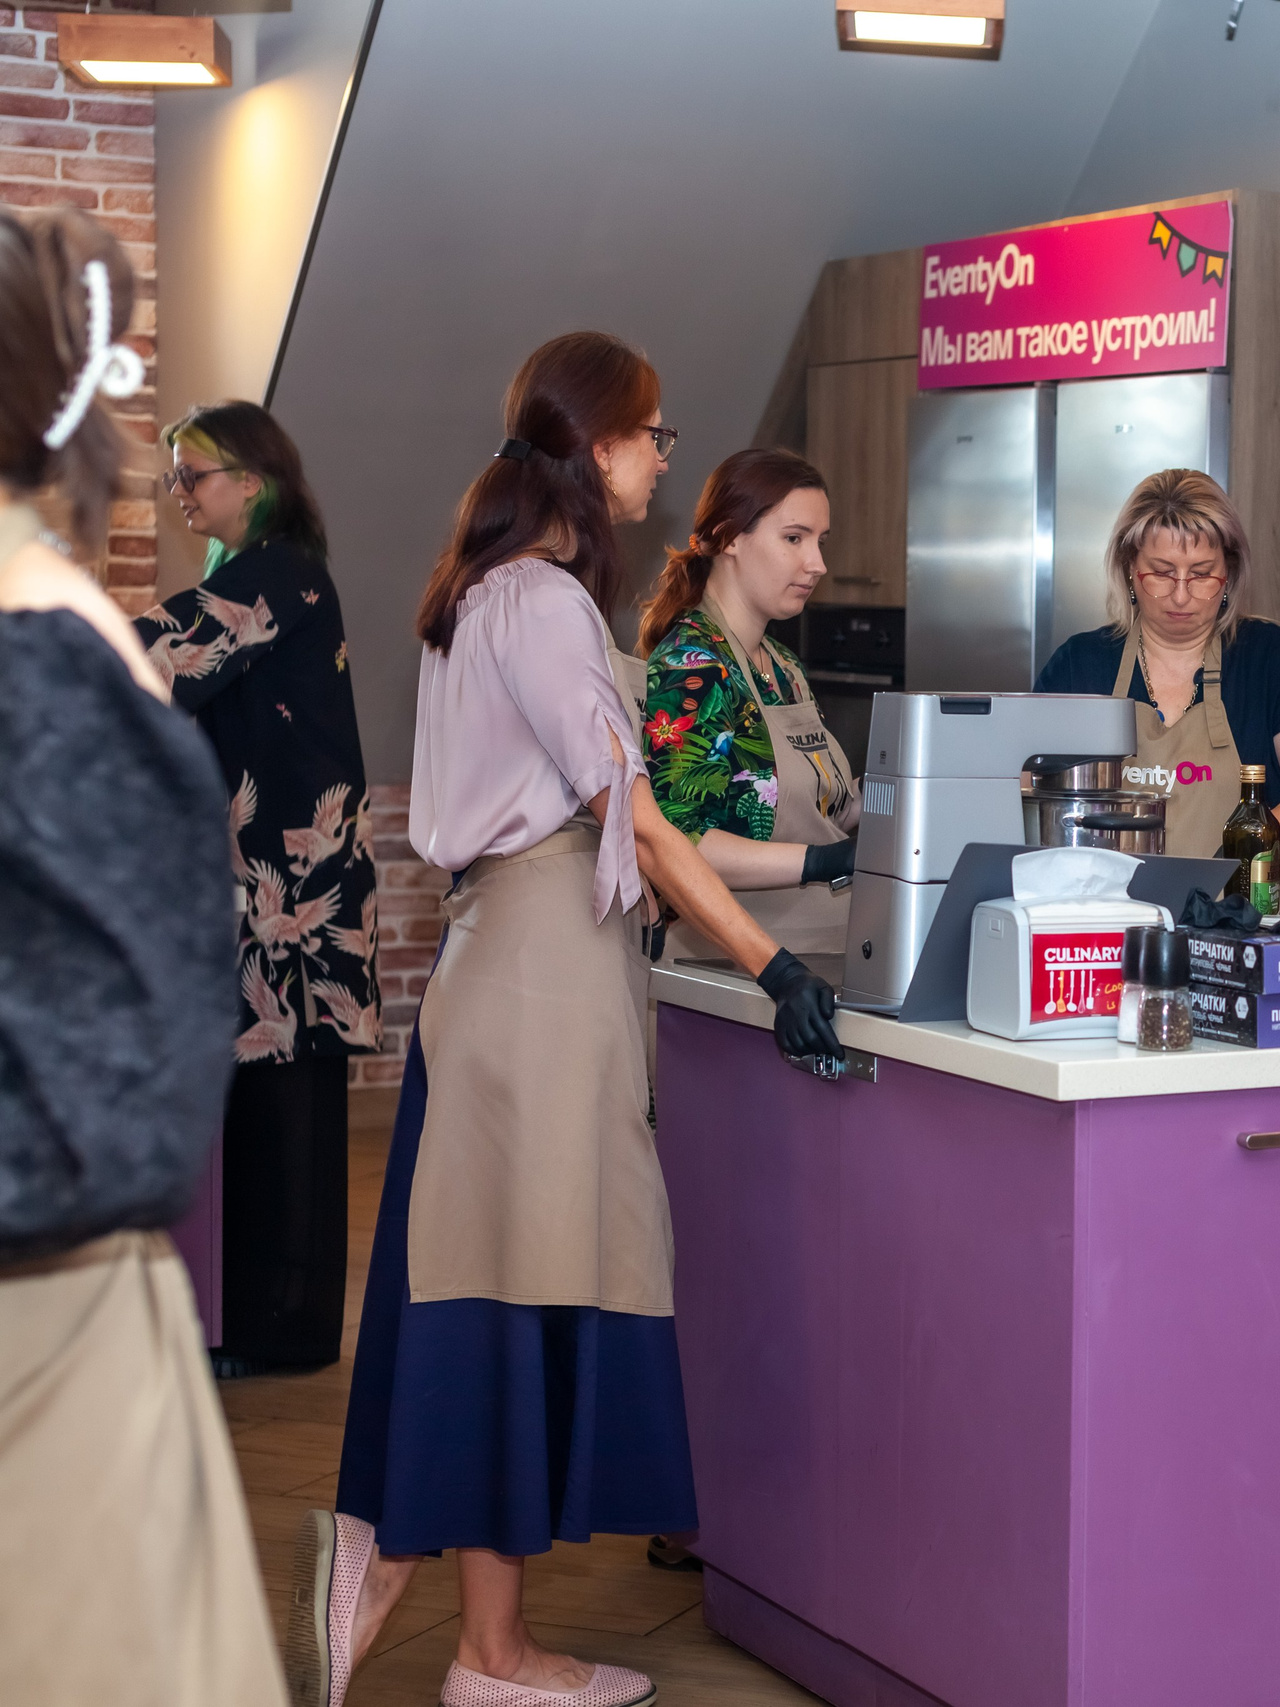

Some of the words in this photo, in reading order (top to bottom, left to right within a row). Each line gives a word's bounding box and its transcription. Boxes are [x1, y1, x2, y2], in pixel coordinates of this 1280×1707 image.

[924, 243, 1035, 306] EventyOn
[921, 326, 962, 367] Мы
[965, 328, 1013, 363] вам
[1016, 321, 1088, 358] такое
[1092, 298, 1217, 365] устроим!
[1044, 946, 1122, 962] CULINARY
[1188, 938, 1234, 962] ПЕРЧАТКИ
[1189, 991, 1226, 1013] РЧАТКИ
